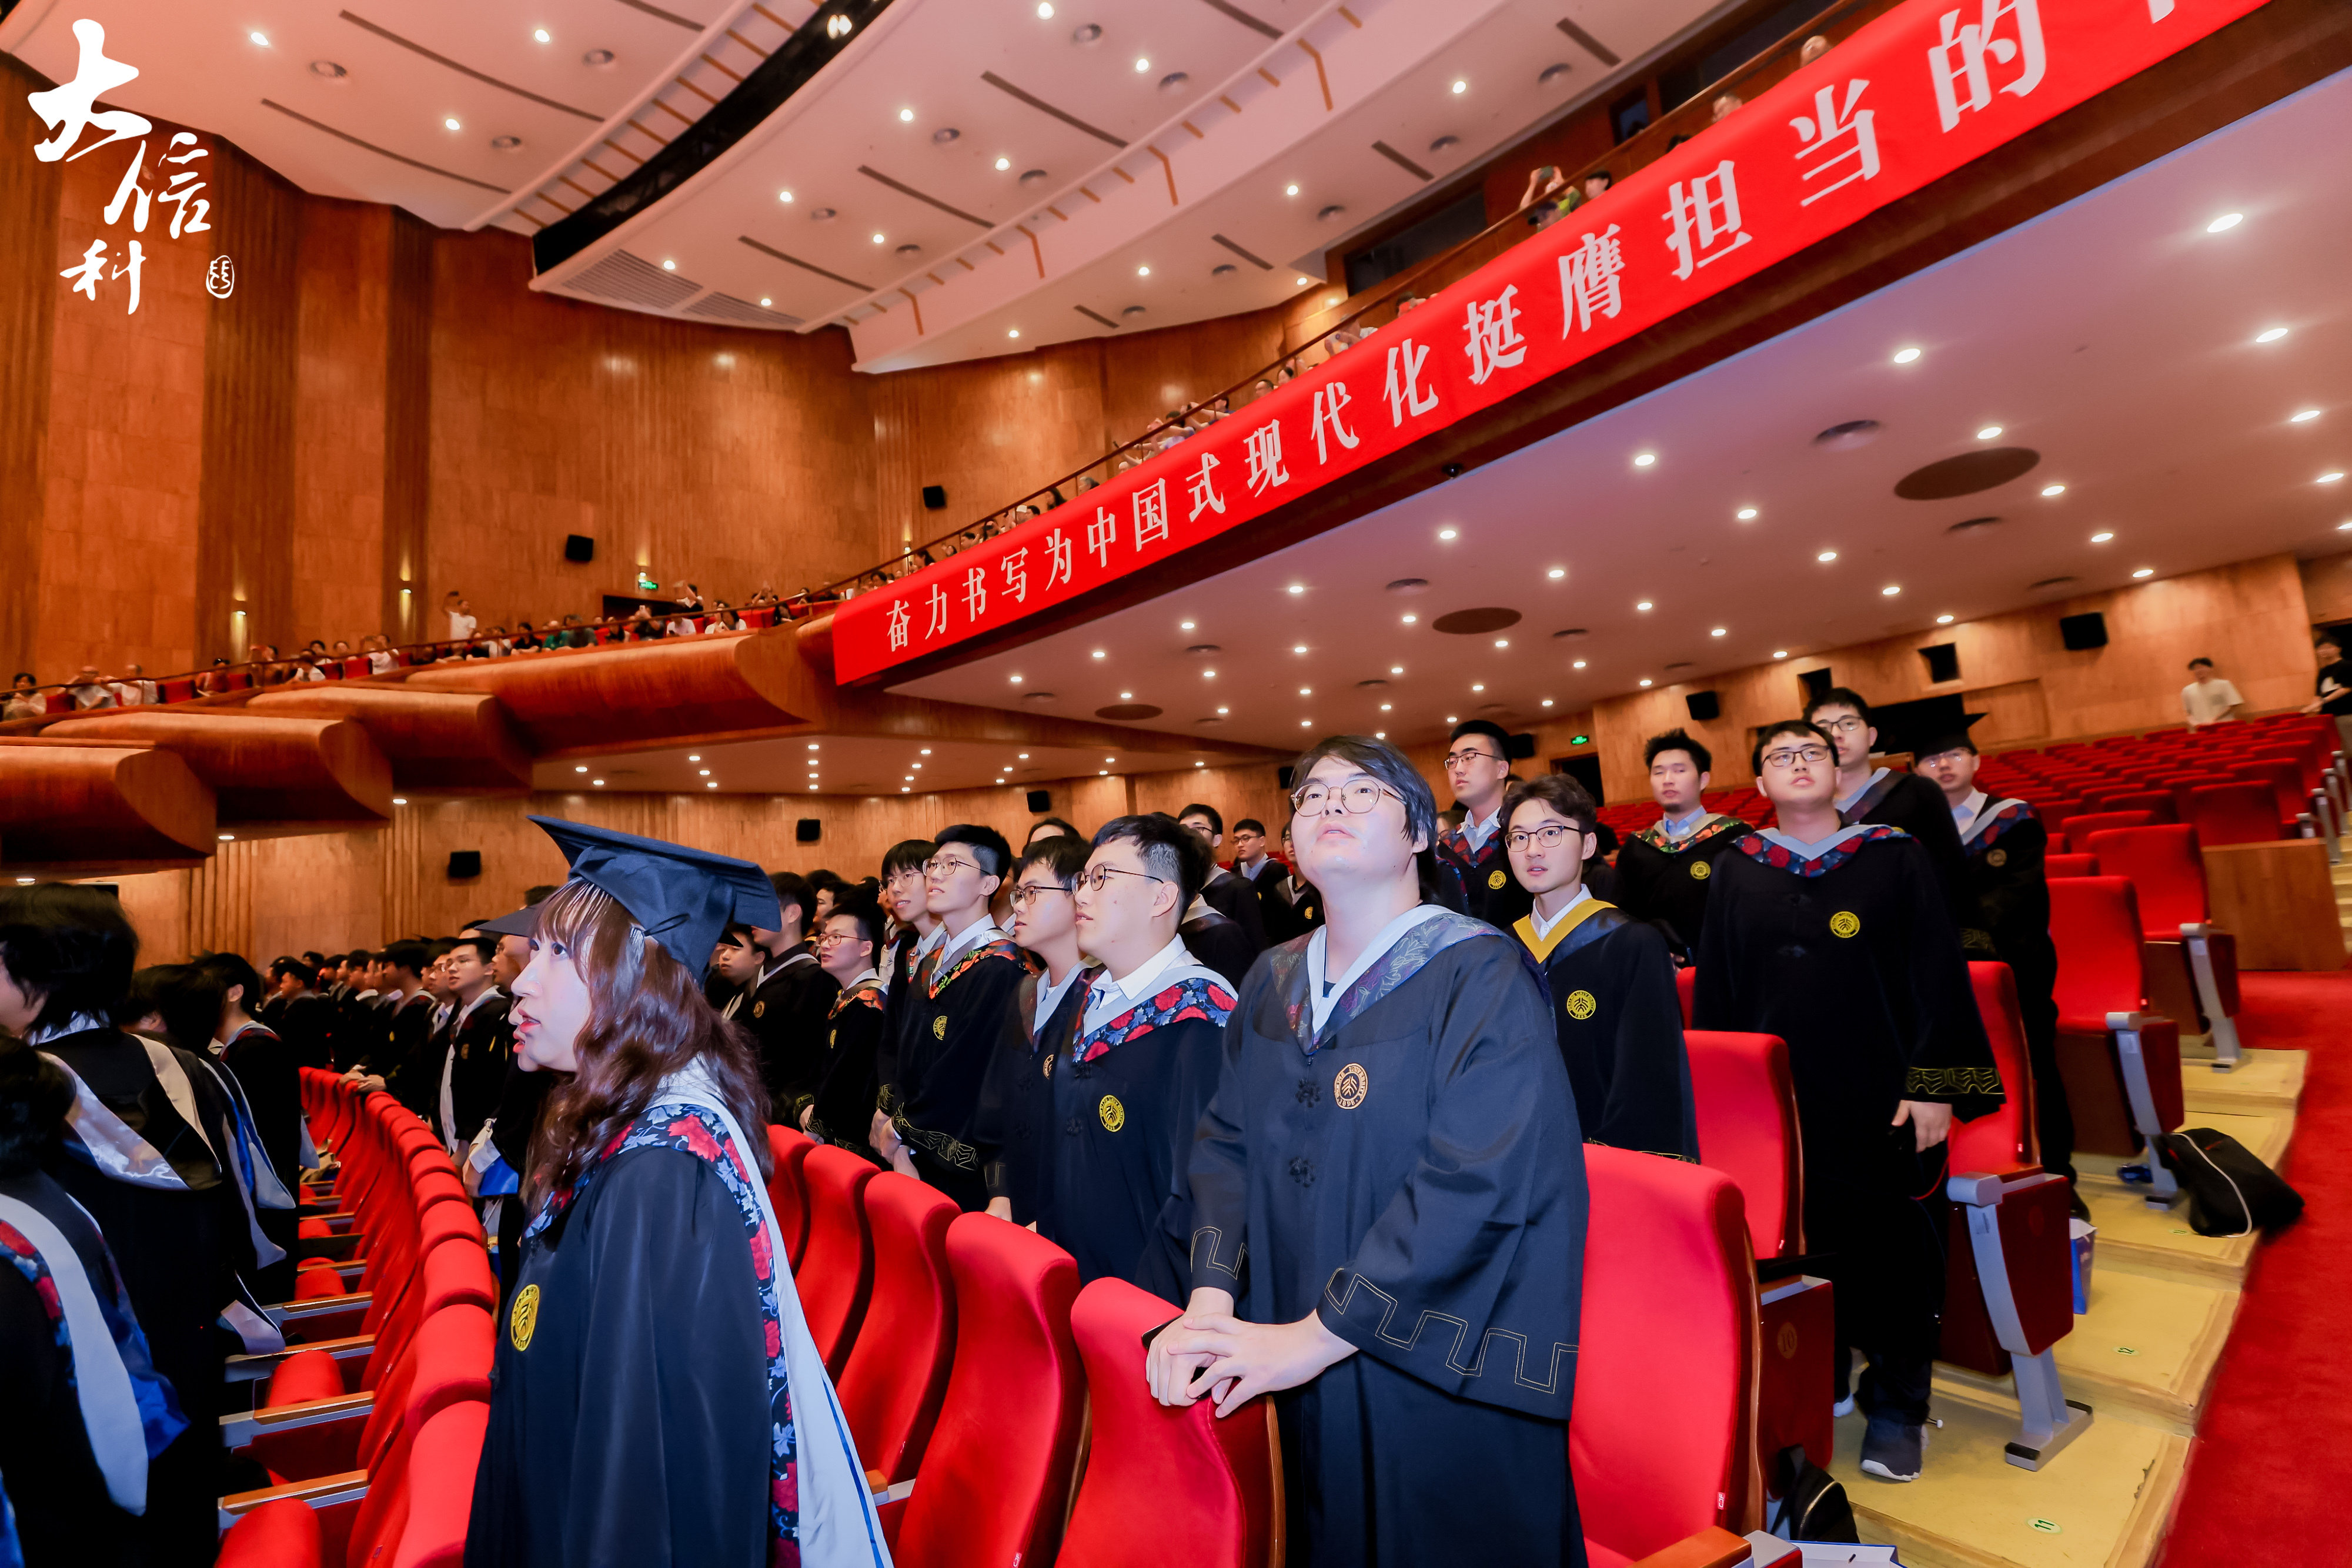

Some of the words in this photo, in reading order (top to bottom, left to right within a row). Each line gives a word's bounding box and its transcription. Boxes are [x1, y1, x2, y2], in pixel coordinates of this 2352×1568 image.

[886, 0, 2175, 653] 奋力书写为中国式现代化挺膺担当的
[2034, 1519, 2055, 1530] 11
